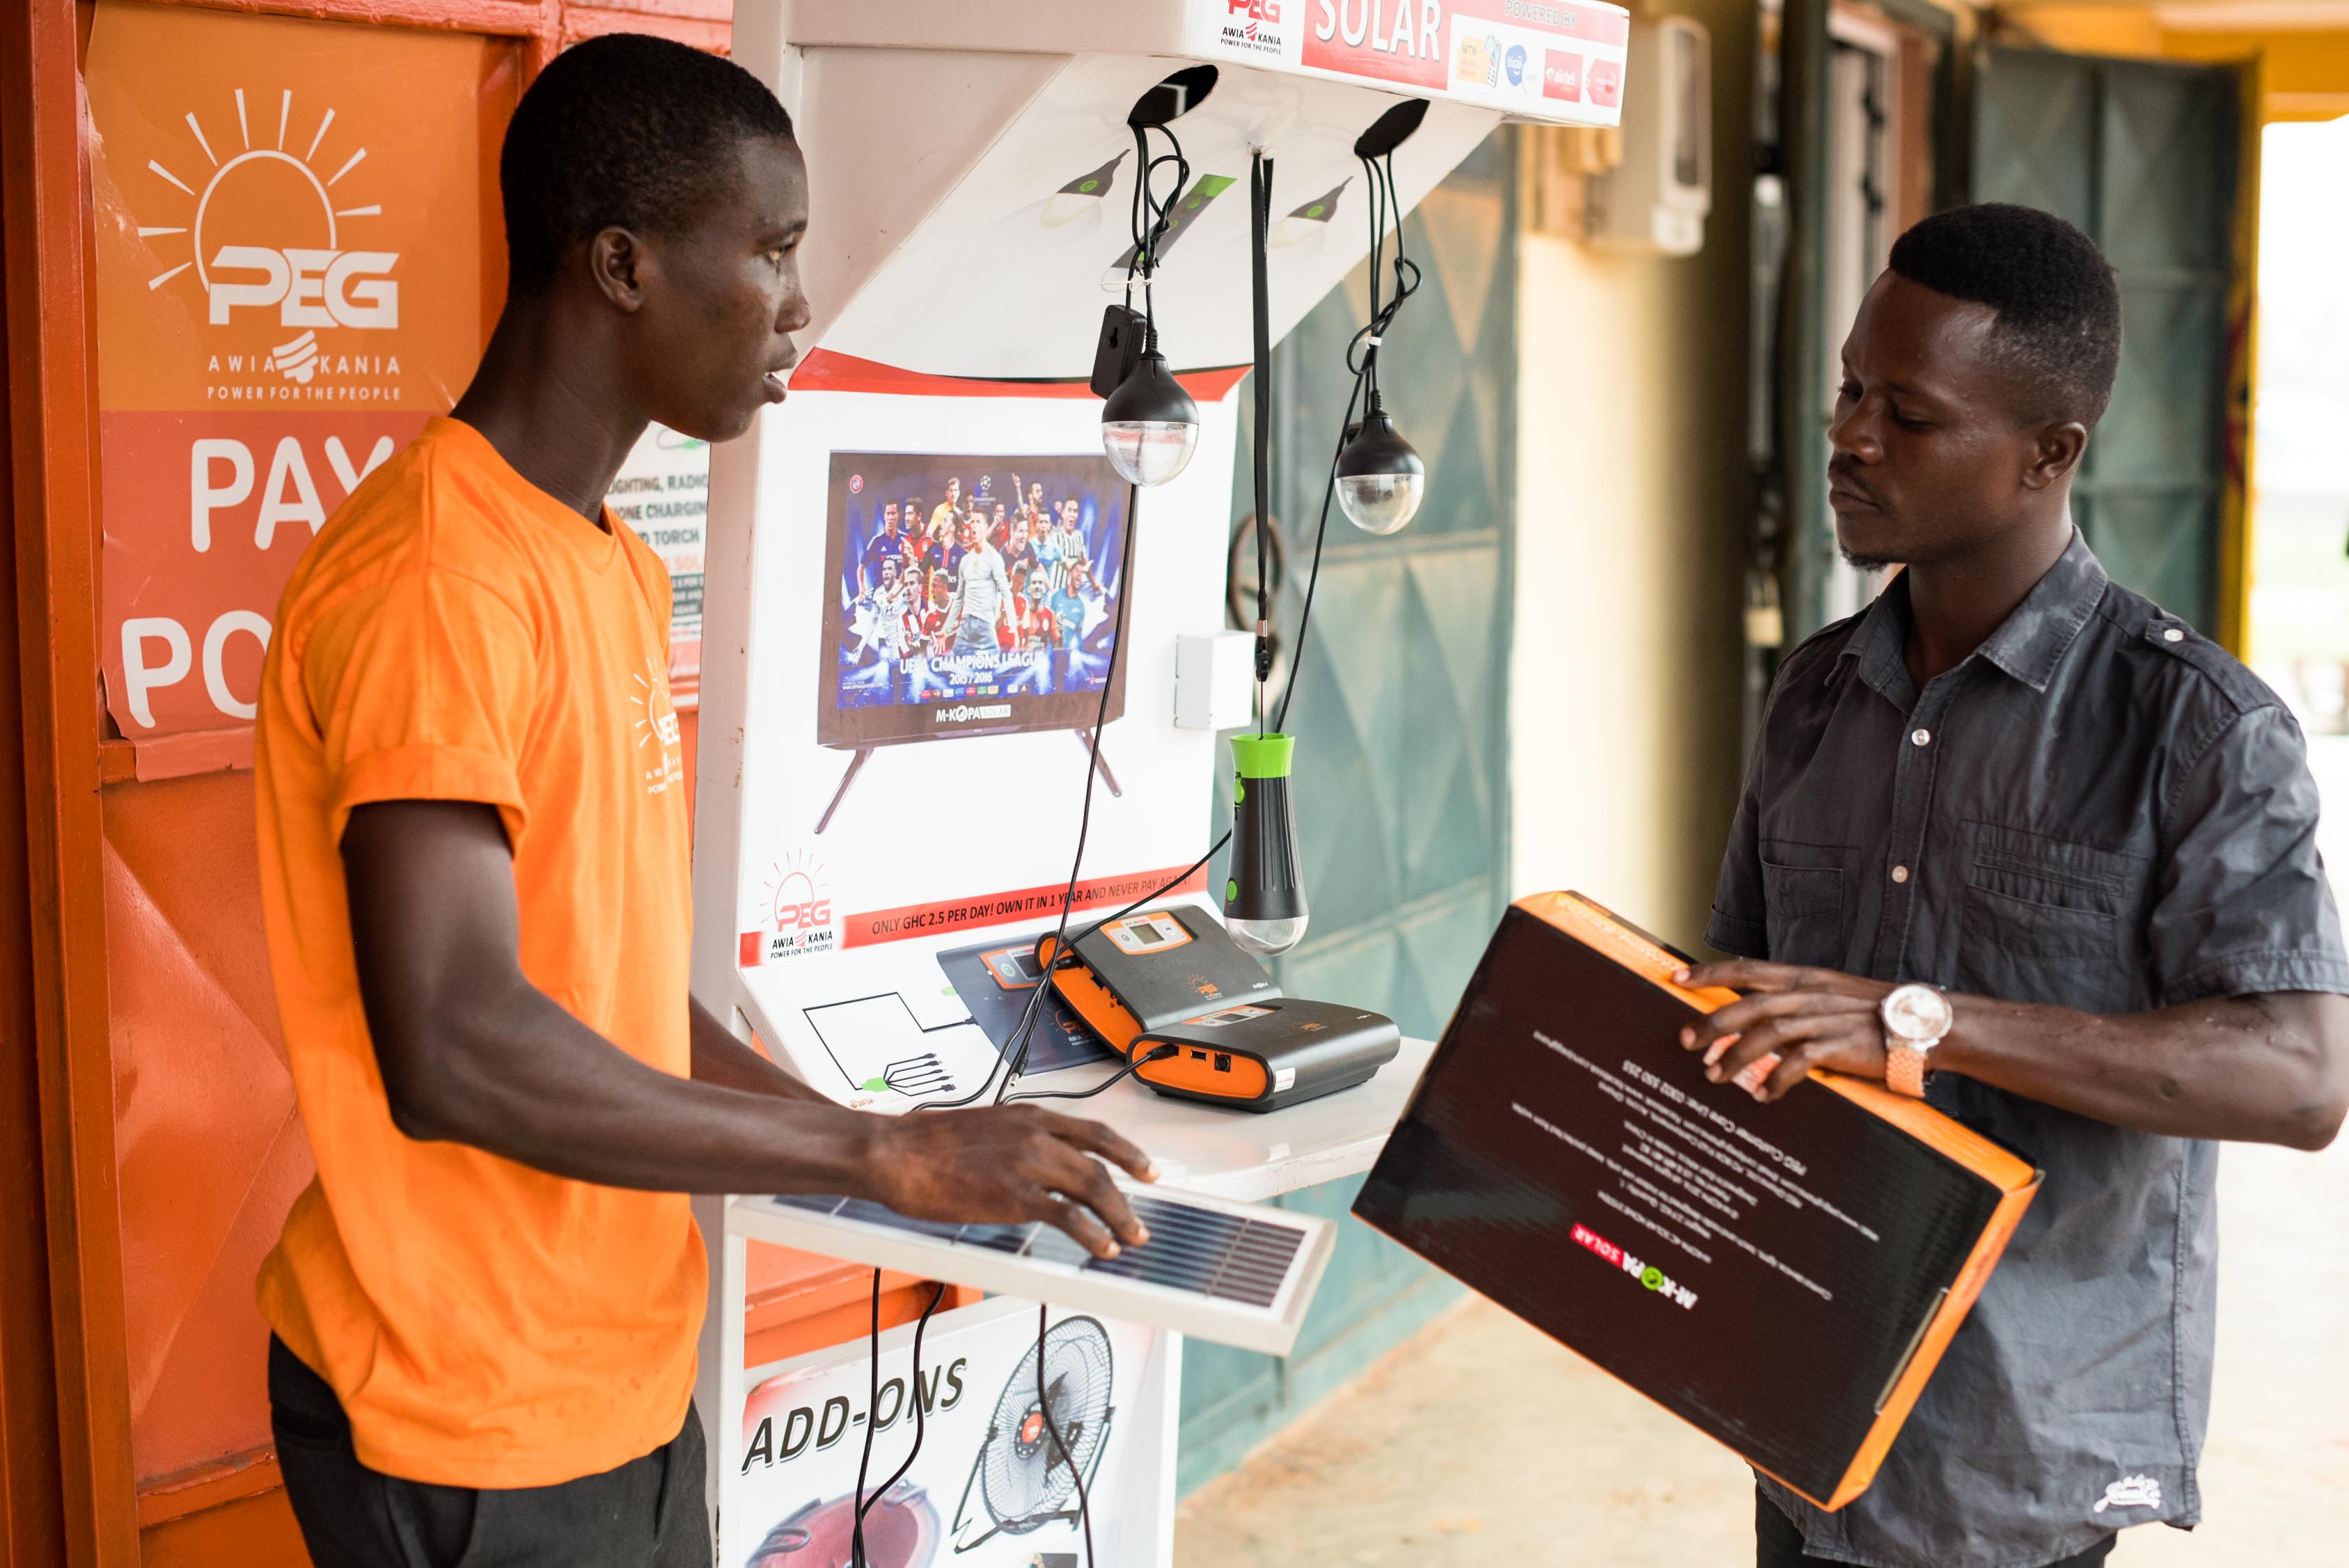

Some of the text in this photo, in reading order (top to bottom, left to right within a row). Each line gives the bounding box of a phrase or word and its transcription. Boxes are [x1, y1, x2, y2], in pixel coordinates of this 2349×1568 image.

[1505, 0, 1577, 29] POWERED BY
[1222, 26, 1281, 46] AWIA KANIA
[1315, 0, 1441, 61] SOLAR
[1220, 38, 1240, 47] POWER
[1264, 46, 1281, 55] PEOPLE
[209, 245, 400, 329] PEG
[209, 354, 400, 375] AWIA KANIA
[207, 386, 400, 401] POWER FOR THE PEOPLE
[191, 436, 394, 553] PAY
[654, 528, 699, 546] TORCH
[932, 654, 999, 673] CHAMPIONS
[1001, 651, 1046, 668] LEAGUE
[949, 673, 967, 685] 2015
[974, 672, 993, 684] 2016
[982, 707, 1008, 717] SOLAR
[778, 898, 831, 932] PEG
[872, 918, 901, 934] ONLY
[903, 914, 926, 930] GHC
[929, 911, 945, 926] 2.5
[948, 908, 967, 923] PER
[970, 903, 994, 919] DAY!
[996, 897, 1023, 915] OWN
[1025, 895, 1035, 911] IT
[1036, 895, 1048, 909] IN
[1050, 894, 1055, 907] 1
[1058, 890, 1083, 905] YEAR
[1085, 887, 1106, 901] AND
[1108, 881, 1138, 897] NEVER
[1141, 879, 1157, 893] PAY
[770, 950, 789, 959] POWER
[803, 946, 812, 954] THE
[815, 943, 833, 952] PEOPLE
[772, 930, 833, 949] AWIA KANIA
[1706, 1109, 1736, 1133] Care
[1734, 1126, 1784, 1161] Customer
[1573, 1226, 1621, 1261] SOLAR
[741, 1358, 967, 1475] ADD-ONS
